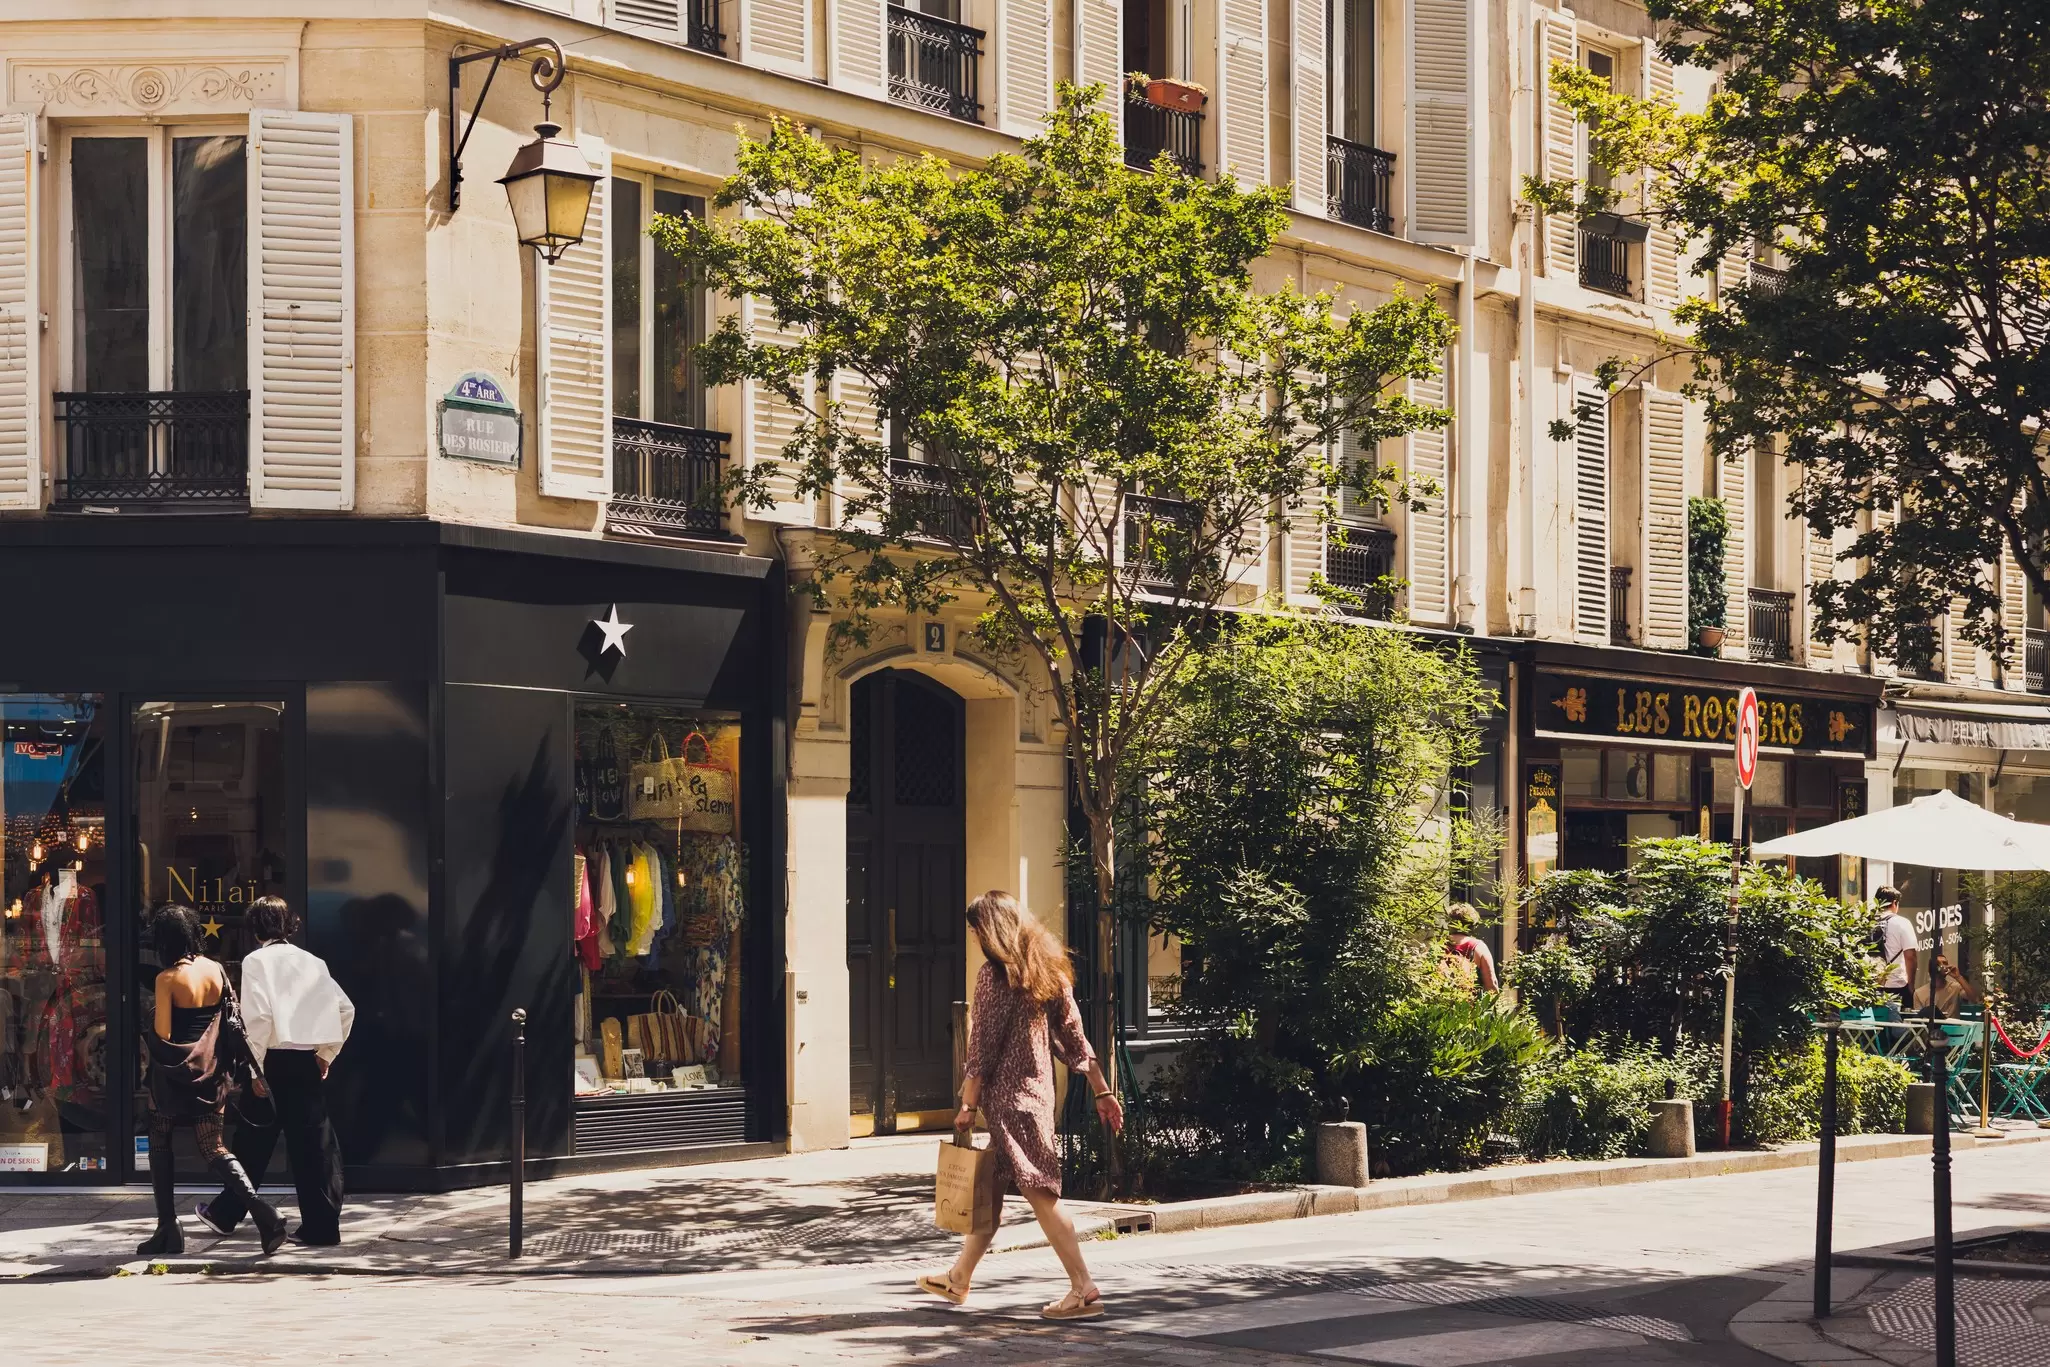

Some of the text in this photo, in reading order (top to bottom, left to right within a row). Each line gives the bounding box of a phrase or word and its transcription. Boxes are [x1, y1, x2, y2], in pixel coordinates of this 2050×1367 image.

[466, 418, 495, 434] RUE
[443, 433, 516, 455] DES ROSIERS
[931, 626, 940, 649] 2
[1616, 687, 1804, 745] LES ROSERS
[1951, 720, 1990, 741] BELAIR
[166, 866, 257, 903] Nilaï
[198, 904, 226, 912] PARIS
[684, 1071, 704, 1082] LOVE
